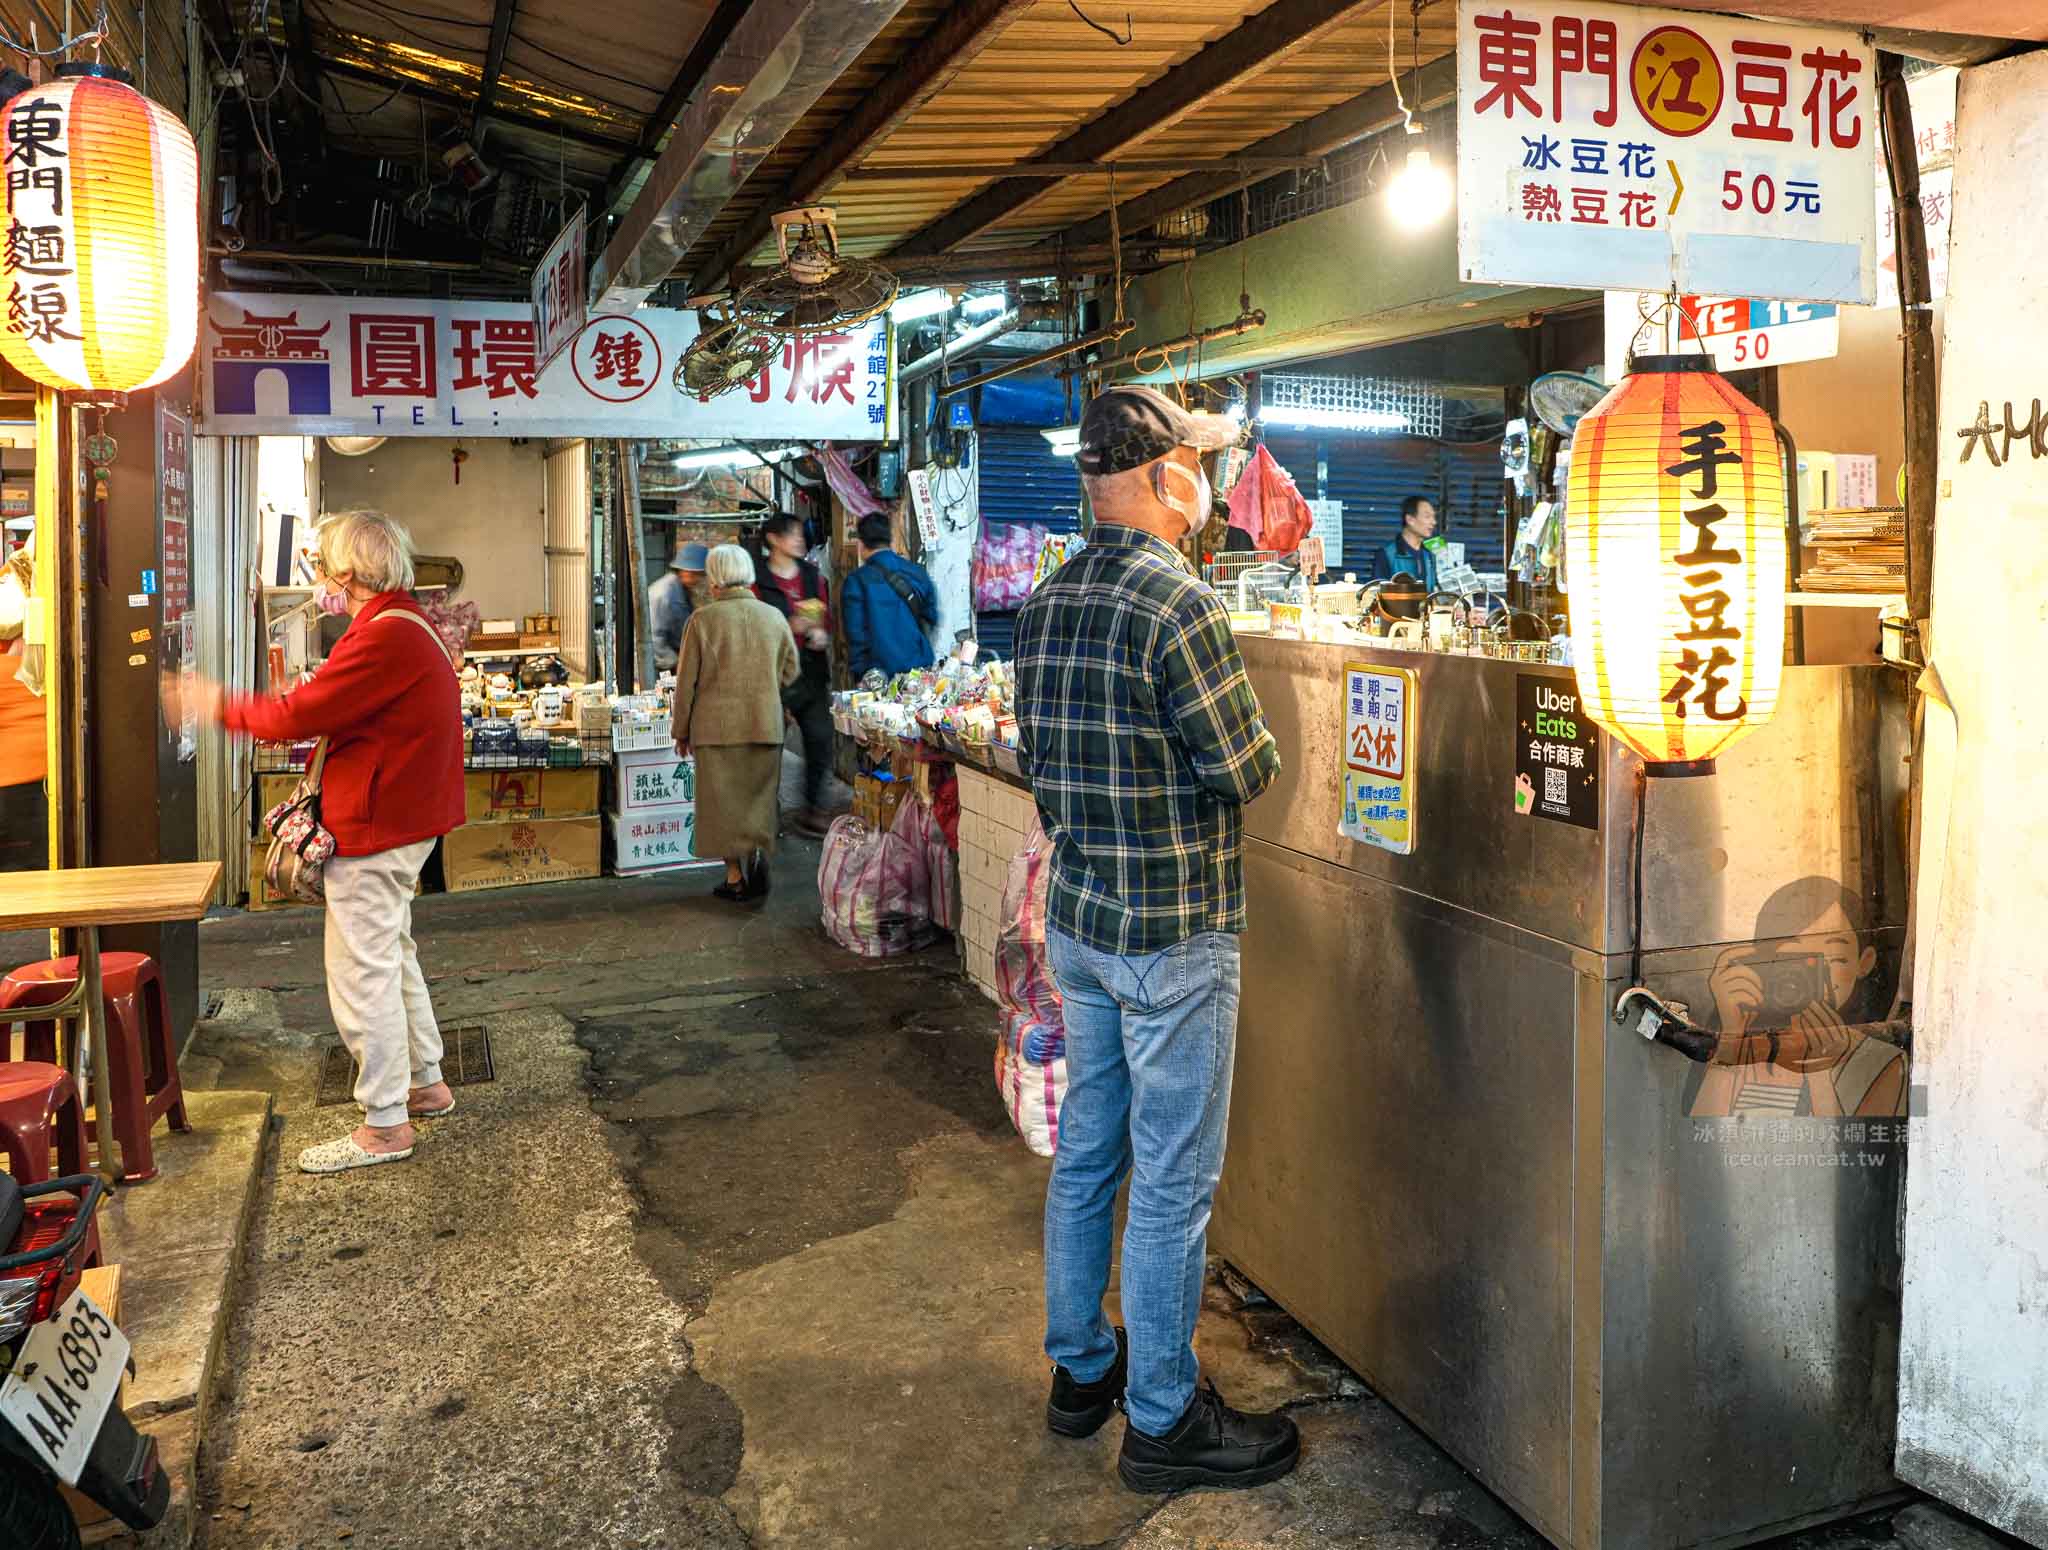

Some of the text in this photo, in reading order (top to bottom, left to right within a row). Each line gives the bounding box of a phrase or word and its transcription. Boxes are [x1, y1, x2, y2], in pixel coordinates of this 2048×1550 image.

[1474, 10, 1617, 127] 東門
[1647, 43, 1706, 117] 江
[1731, 40, 1862, 148] 豆花
[1521, 134, 1656, 178] 冰豆花
[4, 97, 86, 343] 東門麵線
[1522, 182, 1657, 228] 熱豆花
[350, 313, 540, 400] 圓環
[1734, 333, 1769, 362] 50
[1661, 420, 1748, 720] 手工豆花
[1352, 697, 1398, 722] 星期四
[1536, 686, 1577, 713] Uber
[1351, 724, 1398, 768] 公休
[1536, 711, 1577, 740] Eats
[1529, 739, 1585, 769] 合作商家
